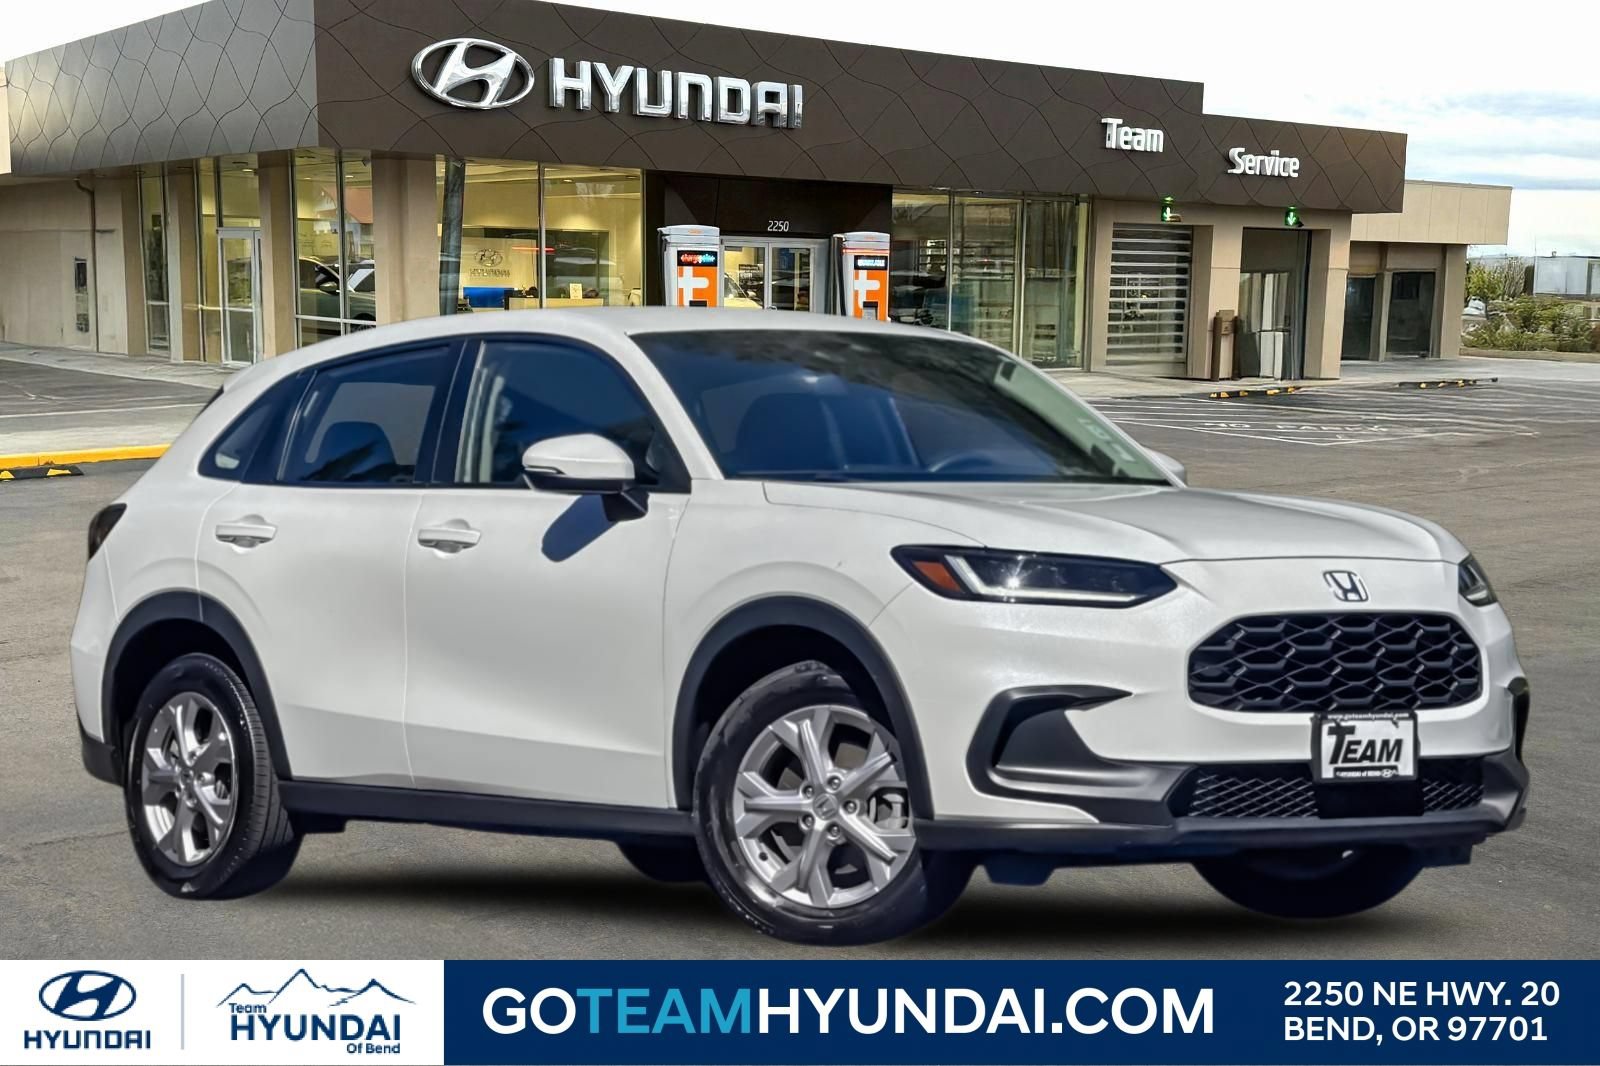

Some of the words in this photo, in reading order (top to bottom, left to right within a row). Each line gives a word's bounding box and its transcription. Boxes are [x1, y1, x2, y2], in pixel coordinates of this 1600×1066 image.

[549, 57, 803, 129] HYUNDAI
[1101, 117, 1164, 152] Team
[1227, 147, 1300, 178] Service
[767, 220, 790, 232] 2250
[1327, 724, 1403, 765] TEAM
